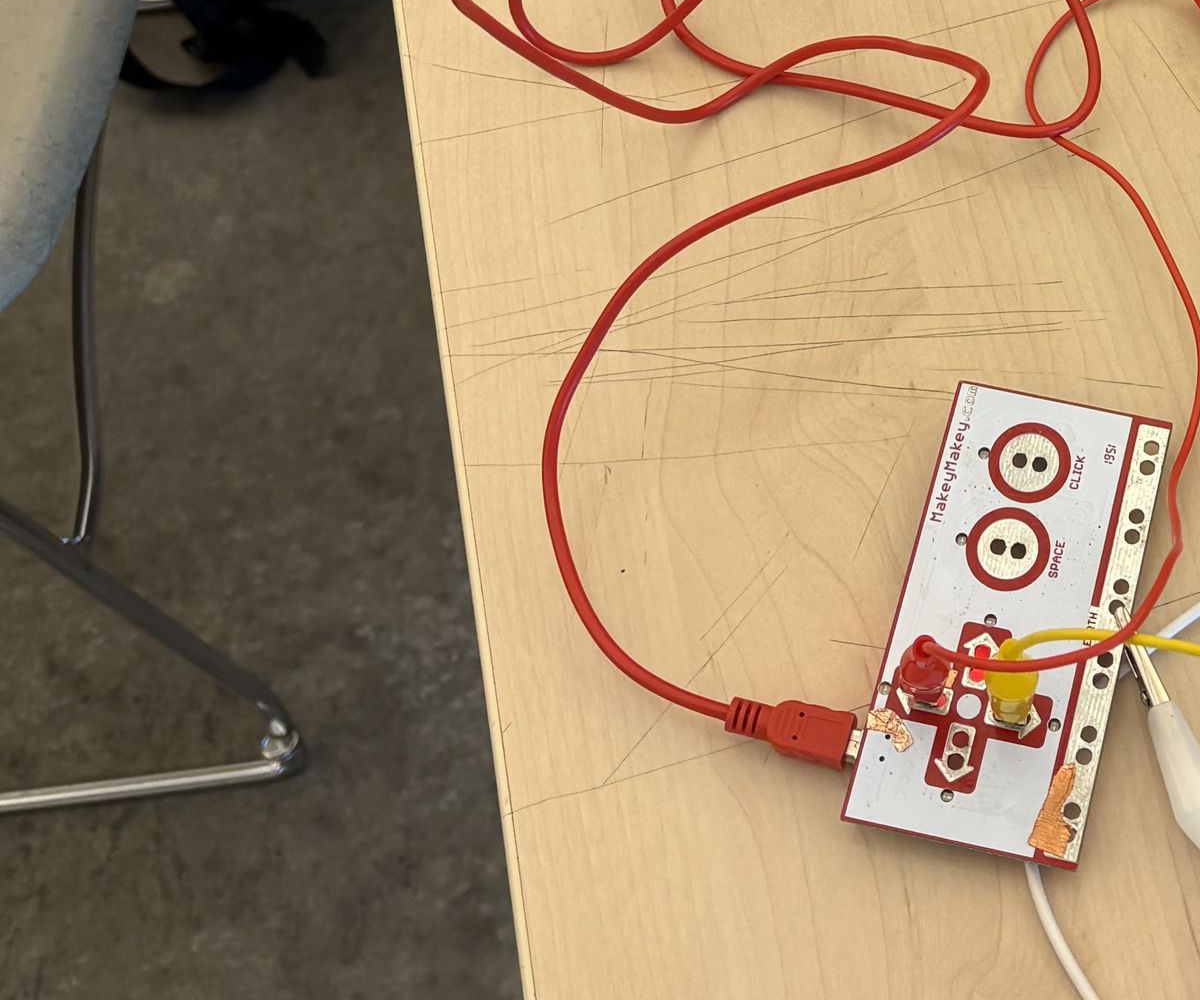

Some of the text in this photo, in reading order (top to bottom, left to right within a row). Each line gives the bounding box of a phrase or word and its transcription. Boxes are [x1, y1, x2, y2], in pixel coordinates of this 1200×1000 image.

[930, 385, 979, 523] MakeyMakey.com
[1069, 455, 1086, 490] CLICK
[1048, 540, 1066, 579] SPACE
[1082, 611, 1099, 647] ETH
